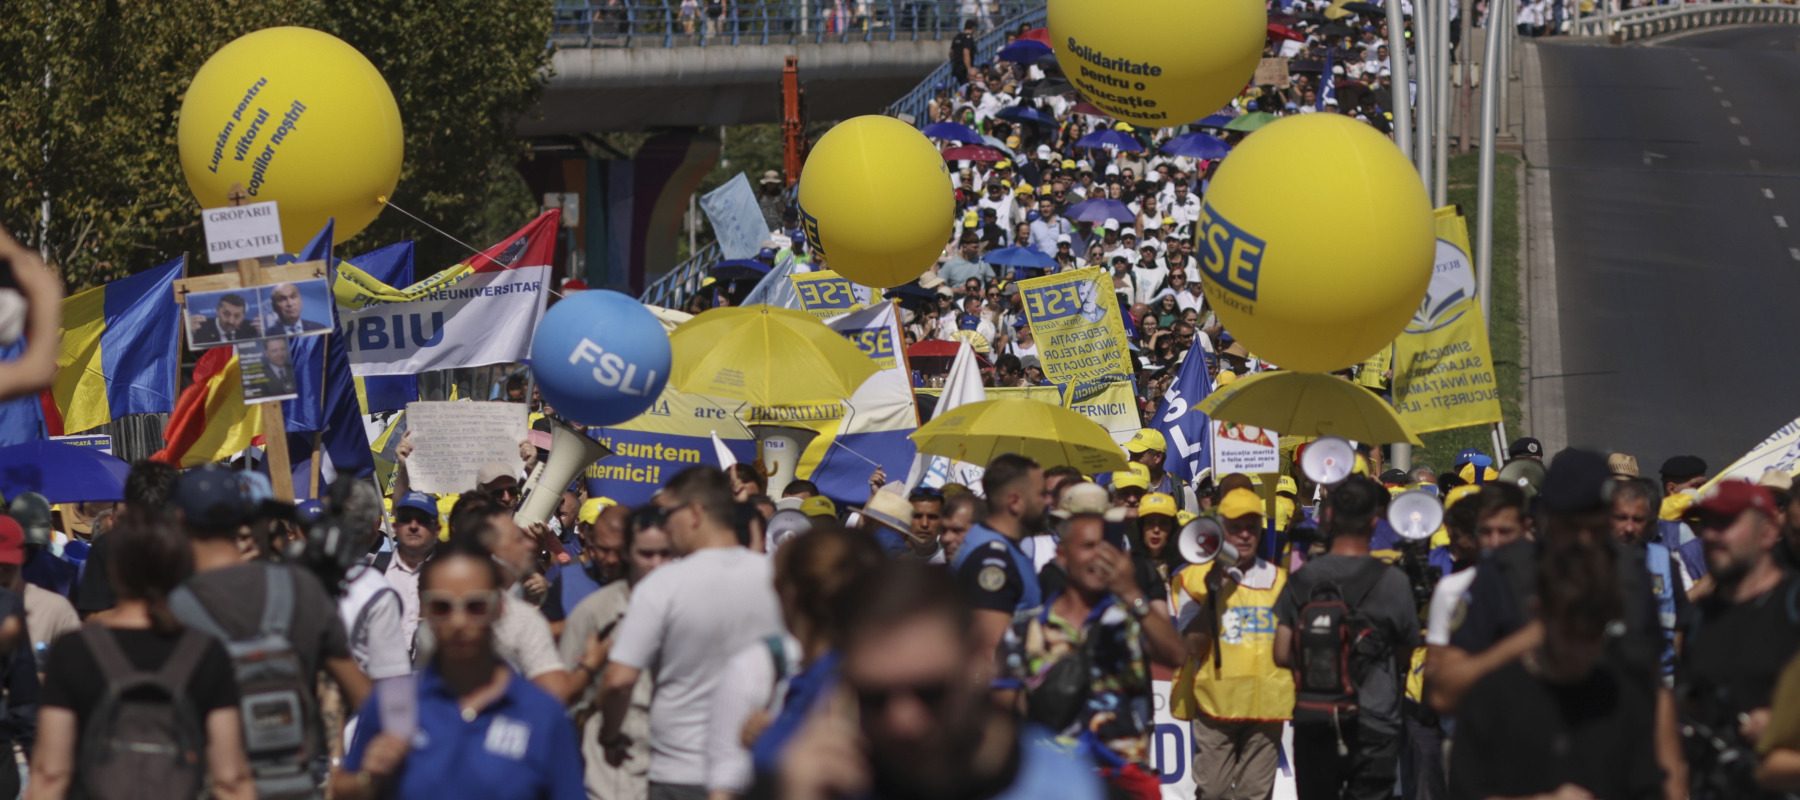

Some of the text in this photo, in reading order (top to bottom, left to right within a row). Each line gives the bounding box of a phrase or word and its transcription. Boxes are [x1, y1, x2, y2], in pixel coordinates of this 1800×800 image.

[1067, 36, 1162, 77] Solidaritate
[1081, 65, 1146, 91] pentru o
[207, 77, 268, 174] Luptăm pentru
[234, 107, 270, 161] viitorul
[247, 99, 307, 197] copiilor noștri!
[209, 205, 271, 222] GROPARII
[210, 234, 279, 252] EDUCAȚIEI
[568, 337, 657, 397] FSLI
[694, 407, 727, 419] are
[750, 403, 845, 421] PRIORITATE!
[615, 442, 701, 463] suntem
